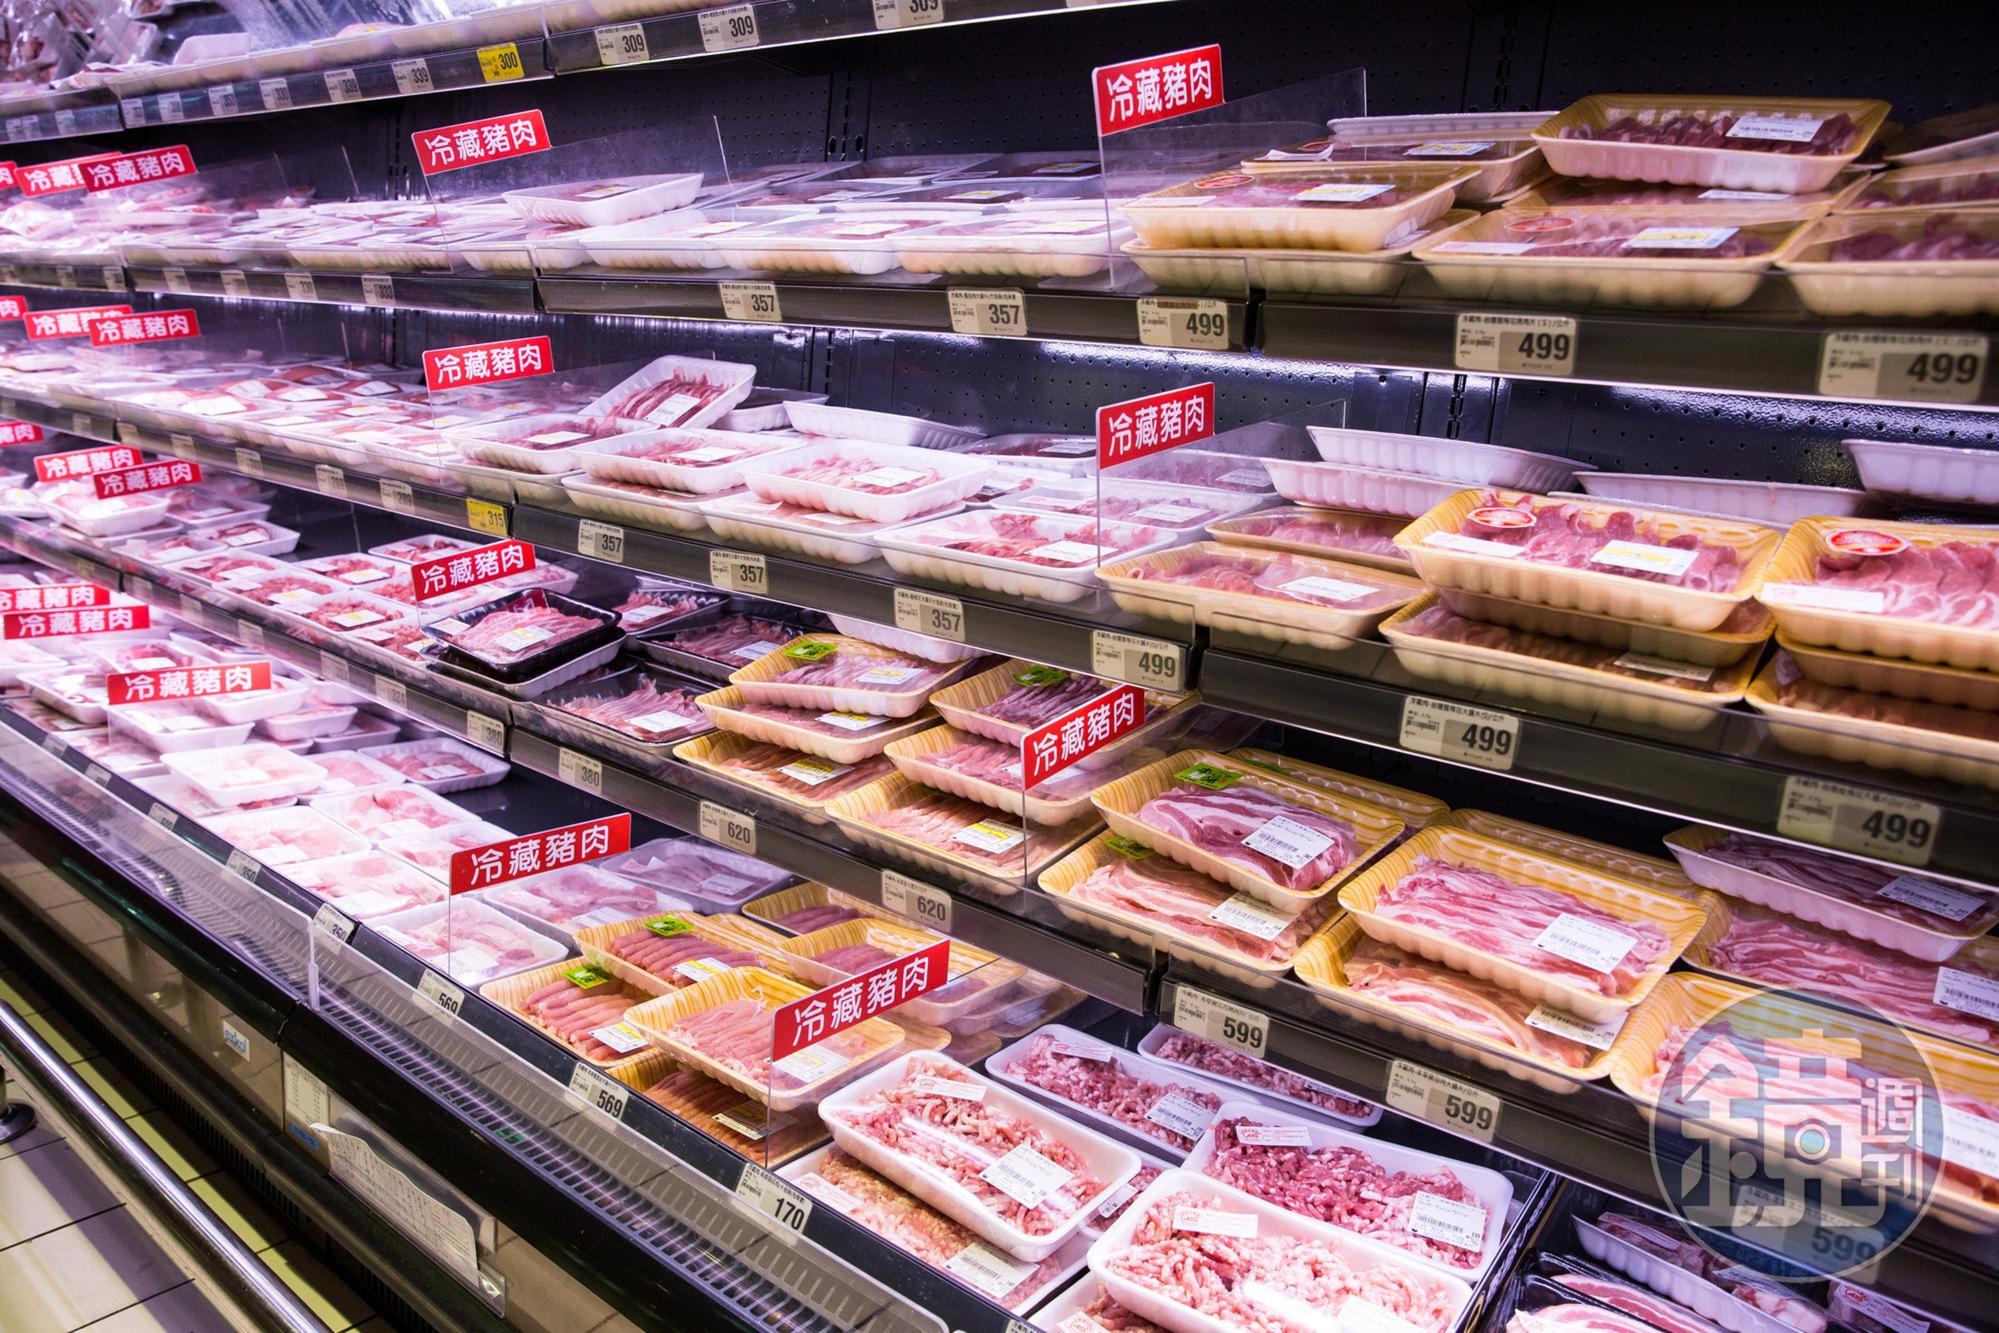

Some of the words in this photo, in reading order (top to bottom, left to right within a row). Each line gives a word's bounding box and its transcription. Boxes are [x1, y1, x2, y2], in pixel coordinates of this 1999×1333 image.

[728, 15, 754, 37] 309
[622, 34, 645, 53] 309
[498, 52, 518, 70] 300
[1107, 57, 1212, 123] 冷藏豬肉
[425, 118, 538, 167] 冷藏豬肉
[24, 163, 85, 192] 冷藏
[88, 151, 186, 188] 冷藏豬肉
[751, 294, 775, 312] 357
[988, 304, 1020, 325] 357
[96, 314, 191, 342] 冷藏豬肉
[1186, 312, 1225, 336] 499
[1518, 332, 1571, 361] 499
[435, 343, 542, 385] 冷藏豬肉
[1906, 353, 1979, 385] 499
[1108, 394, 1206, 457] 冷藏豬肉
[45, 448, 135, 478] 冷藏豬肉
[101, 462, 194, 496] 冷藏豬肉
[488, 510, 504, 528] 315
[602, 534, 622, 553] 357
[420, 542, 525, 595] 冷藏豬肉
[740, 564, 764, 584] 357
[19, 608, 134, 637] 冷藏豬肉
[932, 608, 961, 633] 357
[1139, 651, 1176, 678] 499
[125, 665, 253, 702] 冷藏豬肉
[1033, 691, 1135, 777] 冷藏豬肉
[1462, 723, 1512, 756] 499
[581, 766, 600, 787] 380
[728, 821, 750, 844] 620
[1862, 810, 1930, 848] 499
[470, 824, 610, 887] 冷藏豬肉
[917, 895, 946, 921] 620
[437, 991, 459, 1016] 569
[792, 956, 930, 1048] 冷藏豬肉
[1223, 1016, 1263, 1048] 599
[597, 1090, 622, 1118] 569
[1445, 1094, 1493, 1131] 599
[774, 1197, 805, 1231] 170
